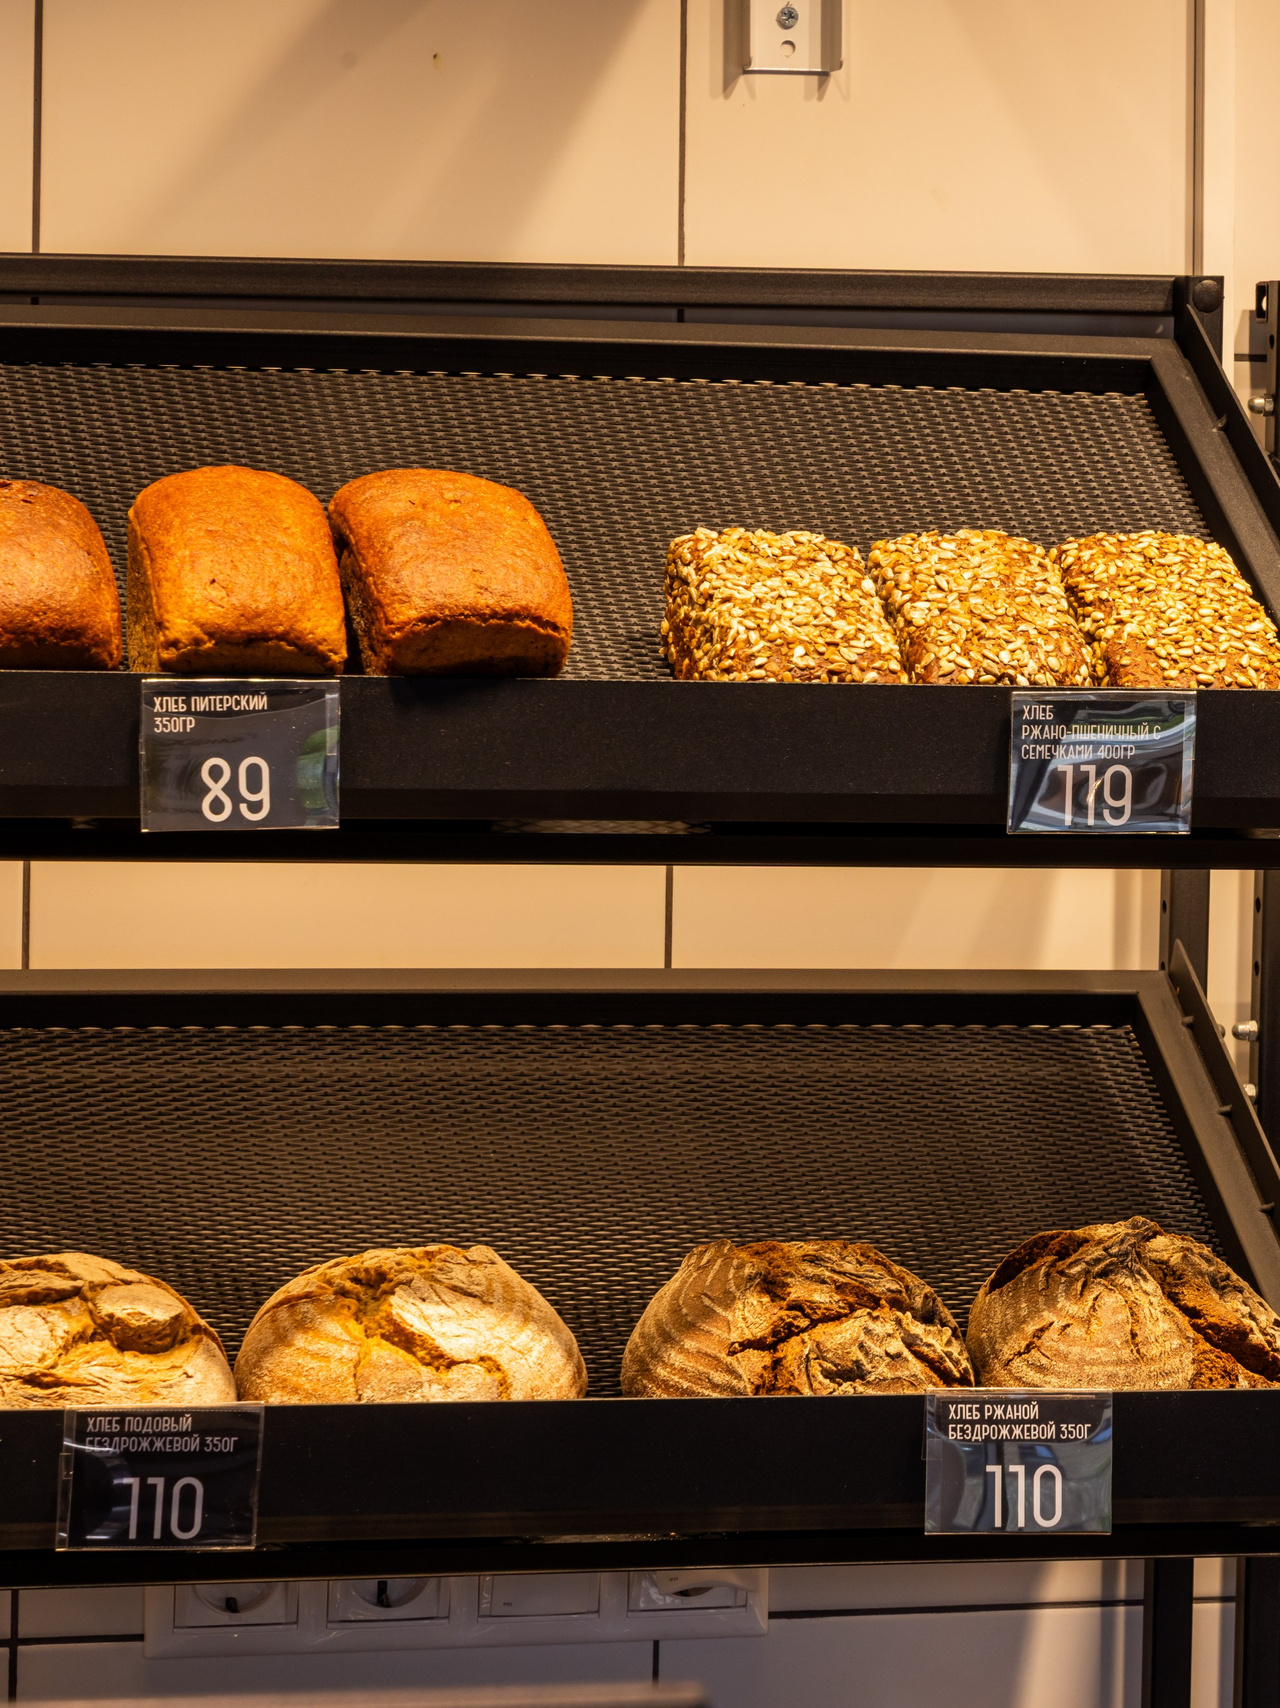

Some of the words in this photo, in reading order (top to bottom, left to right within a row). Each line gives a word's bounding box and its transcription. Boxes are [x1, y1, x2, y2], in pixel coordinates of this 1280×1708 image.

[153, 697, 187, 712] ХЛЕБ
[191, 692, 268, 711] ПИТЕРСКИЙ
[1023, 705, 1053, 720] ХЛЕБ
[154, 717, 195, 732] 350ГР
[1021, 722, 1149, 740] РЖАНО-ПШЕНИЧНЫЙ
[1153, 725, 1161, 740] С
[1021, 745, 1093, 760] СЕМЕЧКАМИ
[1097, 745, 1135, 760] 400ГР
[201, 756, 270, 822] 89
[1057, 764, 1132, 826] 119
[948, 1404, 980, 1420] ХЛЕБ
[984, 1401, 1039, 1420] РЖАНОЙ
[86, 1416, 120, 1433] ХЛЕБ
[124, 1413, 192, 1434] ПОДОВЫЙ
[948, 1421, 1056, 1441] БЕЗДРОЖЖЕВОЙ
[1060, 1423, 1091, 1440] 350Г
[85, 1434, 200, 1454] БЕЗДРОЖЖЕВОЙ
[204, 1436, 238, 1452] 350Г
[985, 1464, 1063, 1528] 110
[122, 1476, 204, 1540] 110
